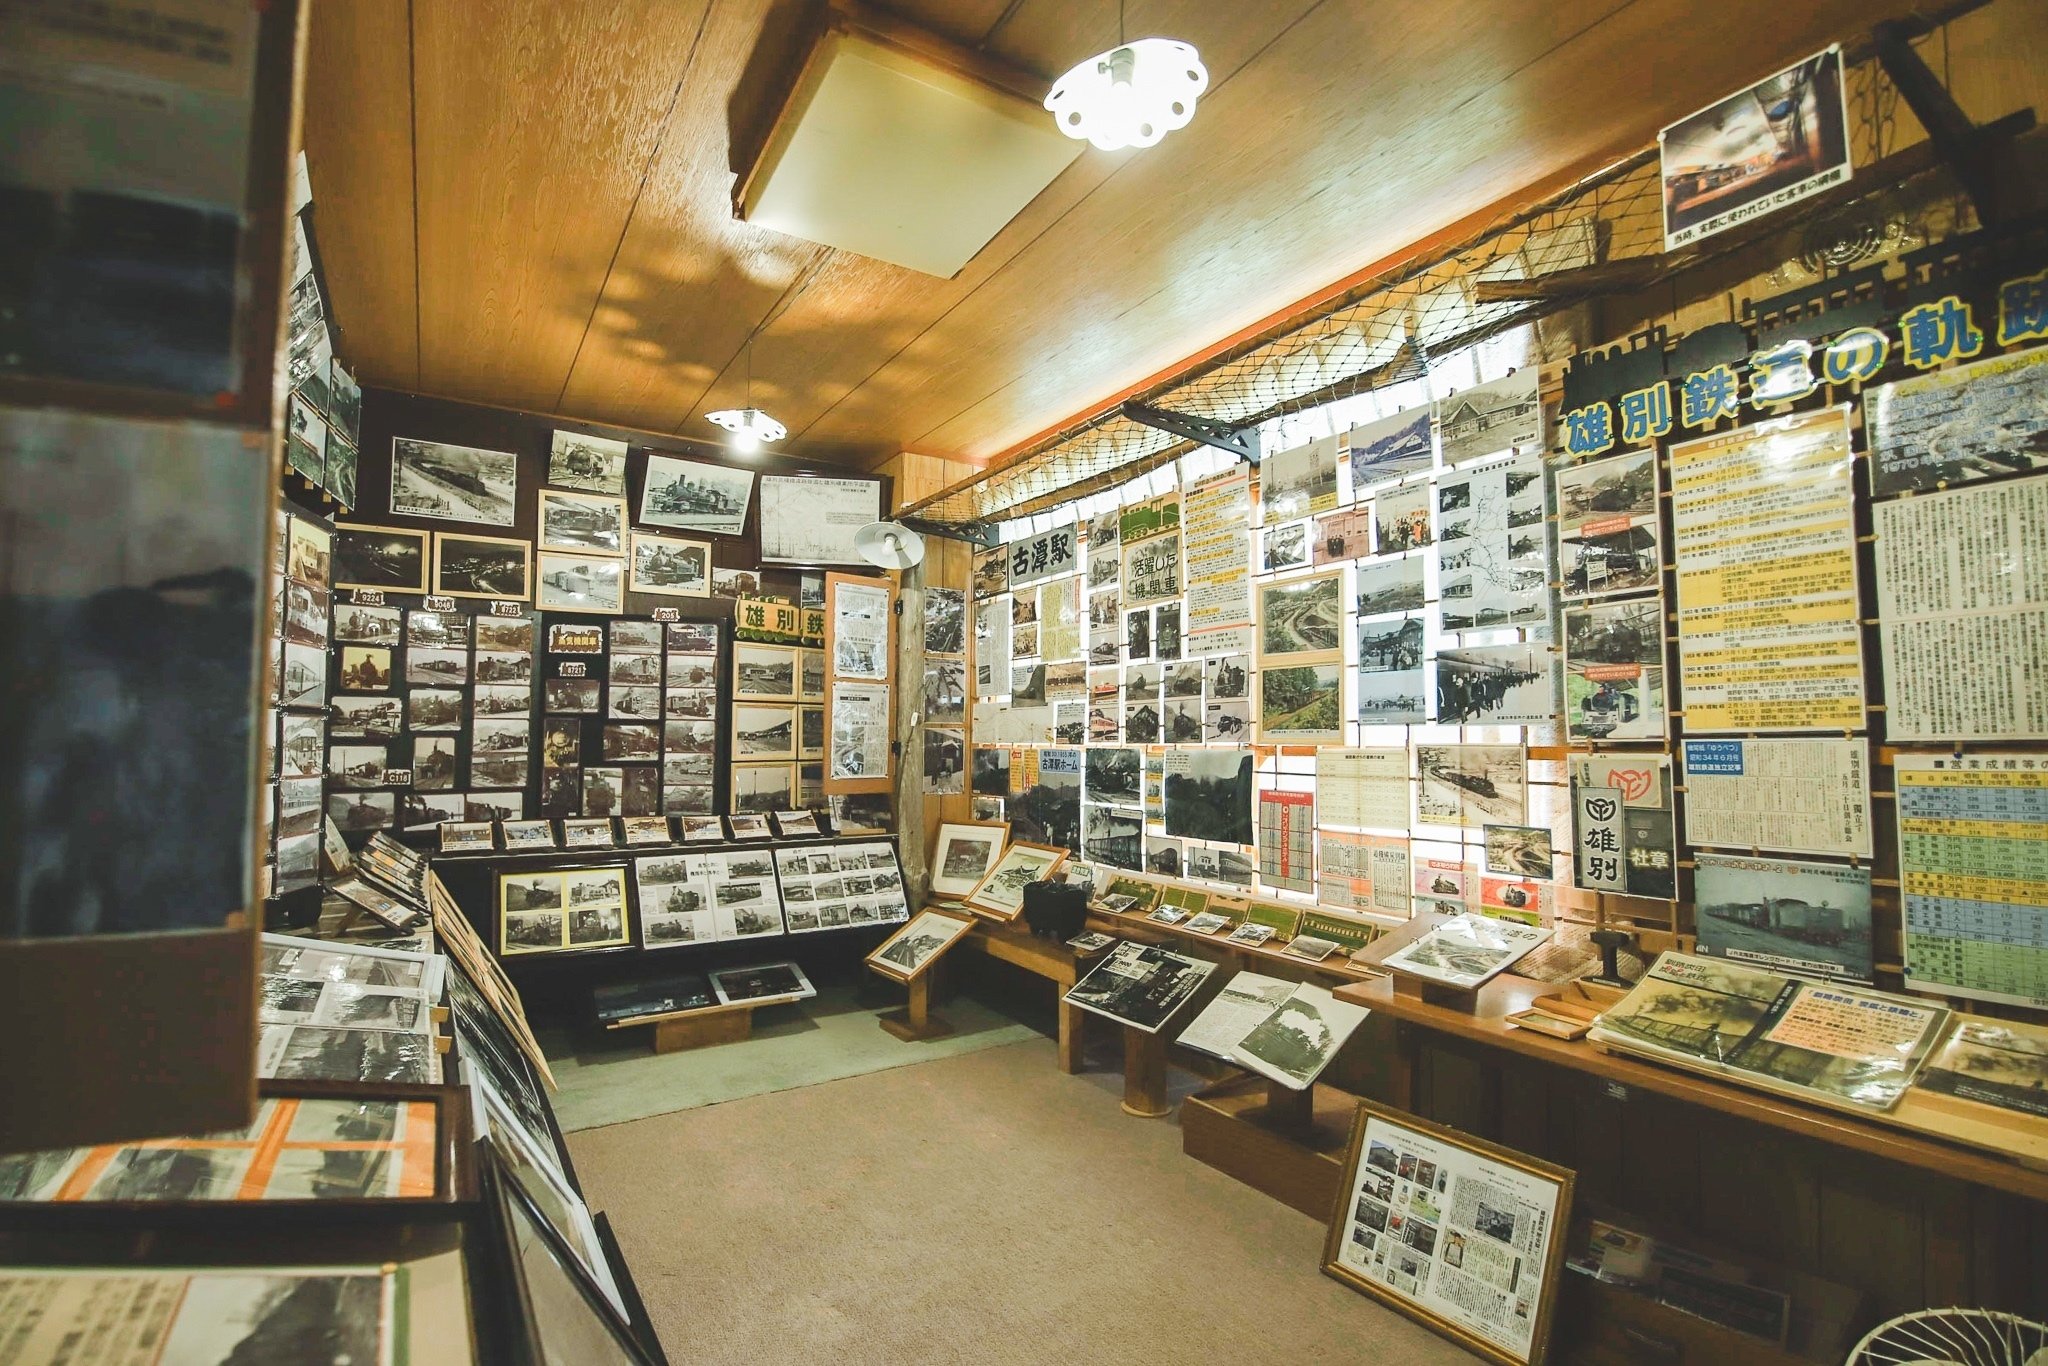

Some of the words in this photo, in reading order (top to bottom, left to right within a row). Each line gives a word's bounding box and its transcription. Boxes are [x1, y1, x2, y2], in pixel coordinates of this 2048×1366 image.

[1013, 533, 1072, 577] 古潭駅
[1134, 553, 1178, 578] 活躍した
[362, 594, 380, 602] 9224
[1135, 576, 1176, 599] 機関車
[661, 612, 675, 620] 205
[745, 604, 795, 631] 雄別
[1042, 759, 1077, 771] 古潭駅ホーム
[1690, 754, 1739, 762] 昭和34年6月号
[1584, 826, 1621, 883] 雄別
[1631, 848, 1669, 869] 社章
